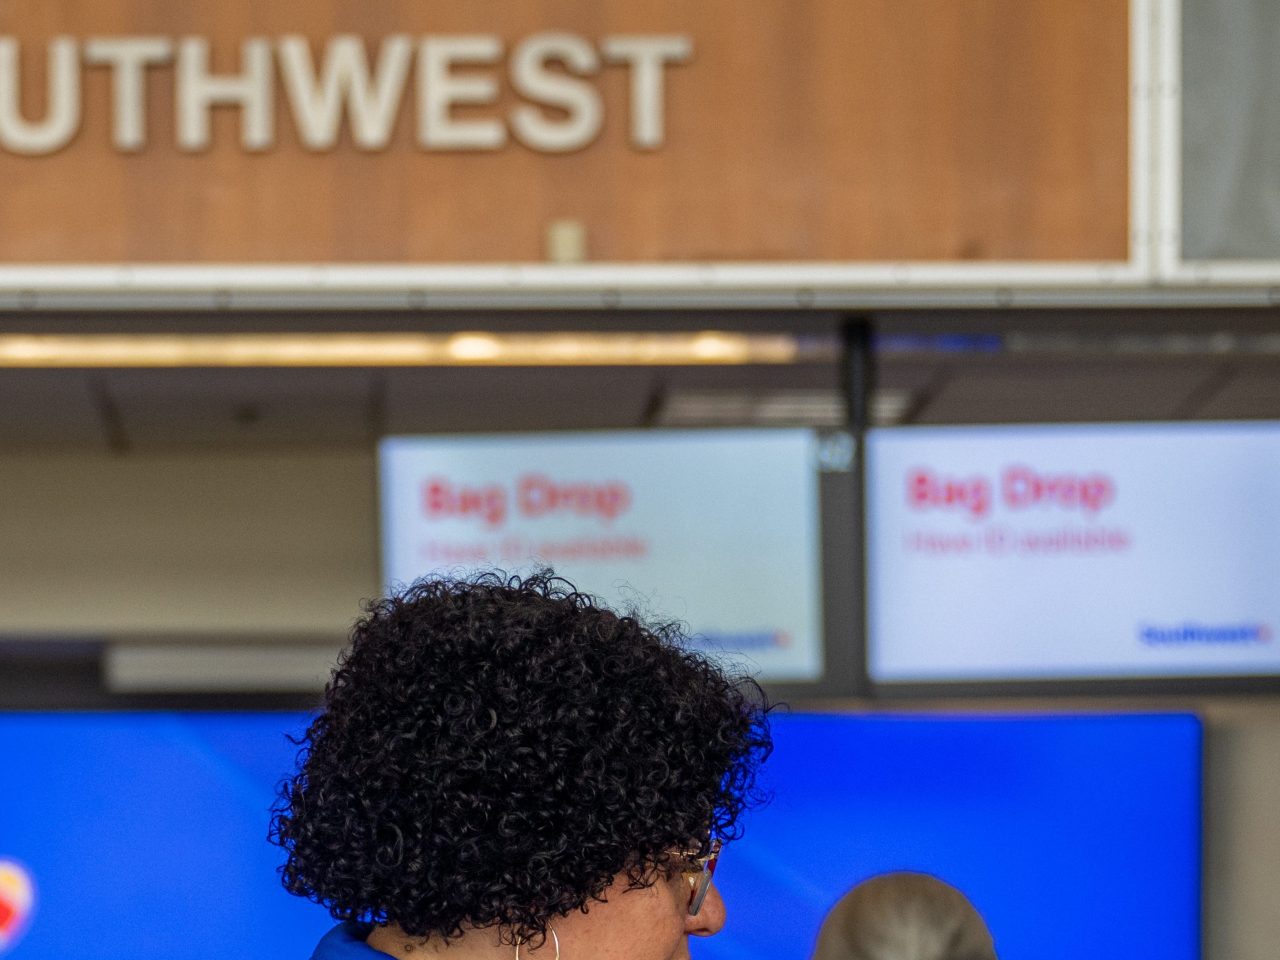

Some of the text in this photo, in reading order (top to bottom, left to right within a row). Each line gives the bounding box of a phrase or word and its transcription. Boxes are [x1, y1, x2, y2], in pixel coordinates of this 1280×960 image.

[425, 473, 630, 527] Bag Drop
[907, 464, 1116, 519] Bag Drop
